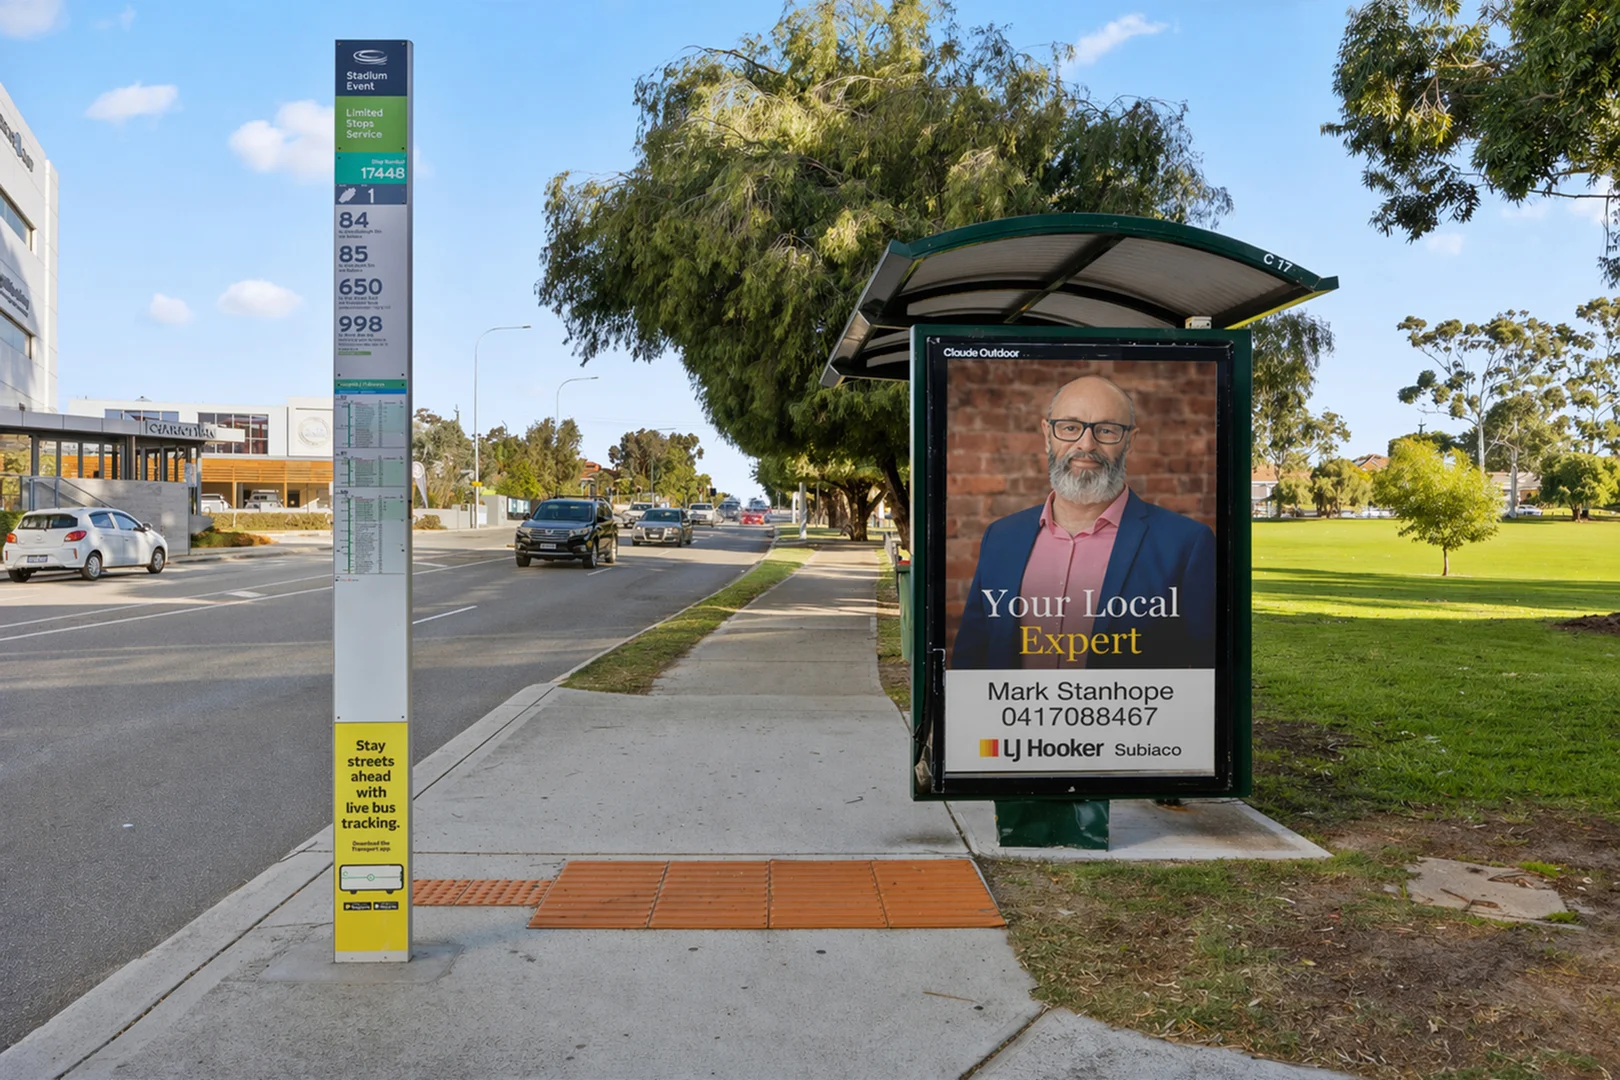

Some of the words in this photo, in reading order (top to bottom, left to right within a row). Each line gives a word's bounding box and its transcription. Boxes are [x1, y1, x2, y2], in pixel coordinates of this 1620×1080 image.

[346, 71, 388, 80] Stadium
[346, 81, 375, 91] Event
[346, 108, 384, 117] Limited
[346, 119, 374, 129] Stops
[346, 130, 382, 139] Service
[361, 167, 405, 179] 17448
[368, 188, 374, 203] 1
[339, 211, 369, 228] 84
[339, 245, 368, 263] 85
[1263, 253, 1275, 265] C
[1277, 259, 1293, 273] 17
[339, 278, 383, 295] 650
[339, 315, 383, 332] 998
[979, 348, 1020, 358] Outdoor
[981, 589, 1071, 618] Your
[1083, 586, 1180, 618] Local
[1019, 625, 1142, 662] Expert
[988, 682, 1049, 701] Mark
[1057, 681, 1174, 705] Stanhope
[1002, 707, 1158, 726] 0417088467
[356, 740, 386, 754] Stay
[1003, 739, 1021, 762] LJ
[1027, 738, 1104, 757] Hooker
[1114, 743, 1182, 757] Subiaco
[347, 755, 394, 767] streets
[350, 770, 391, 782] ahead
[356, 786, 387, 798] with
[346, 801, 369, 814] live
[372, 801, 396, 814] bus
[341, 817, 400, 831] tracking.
